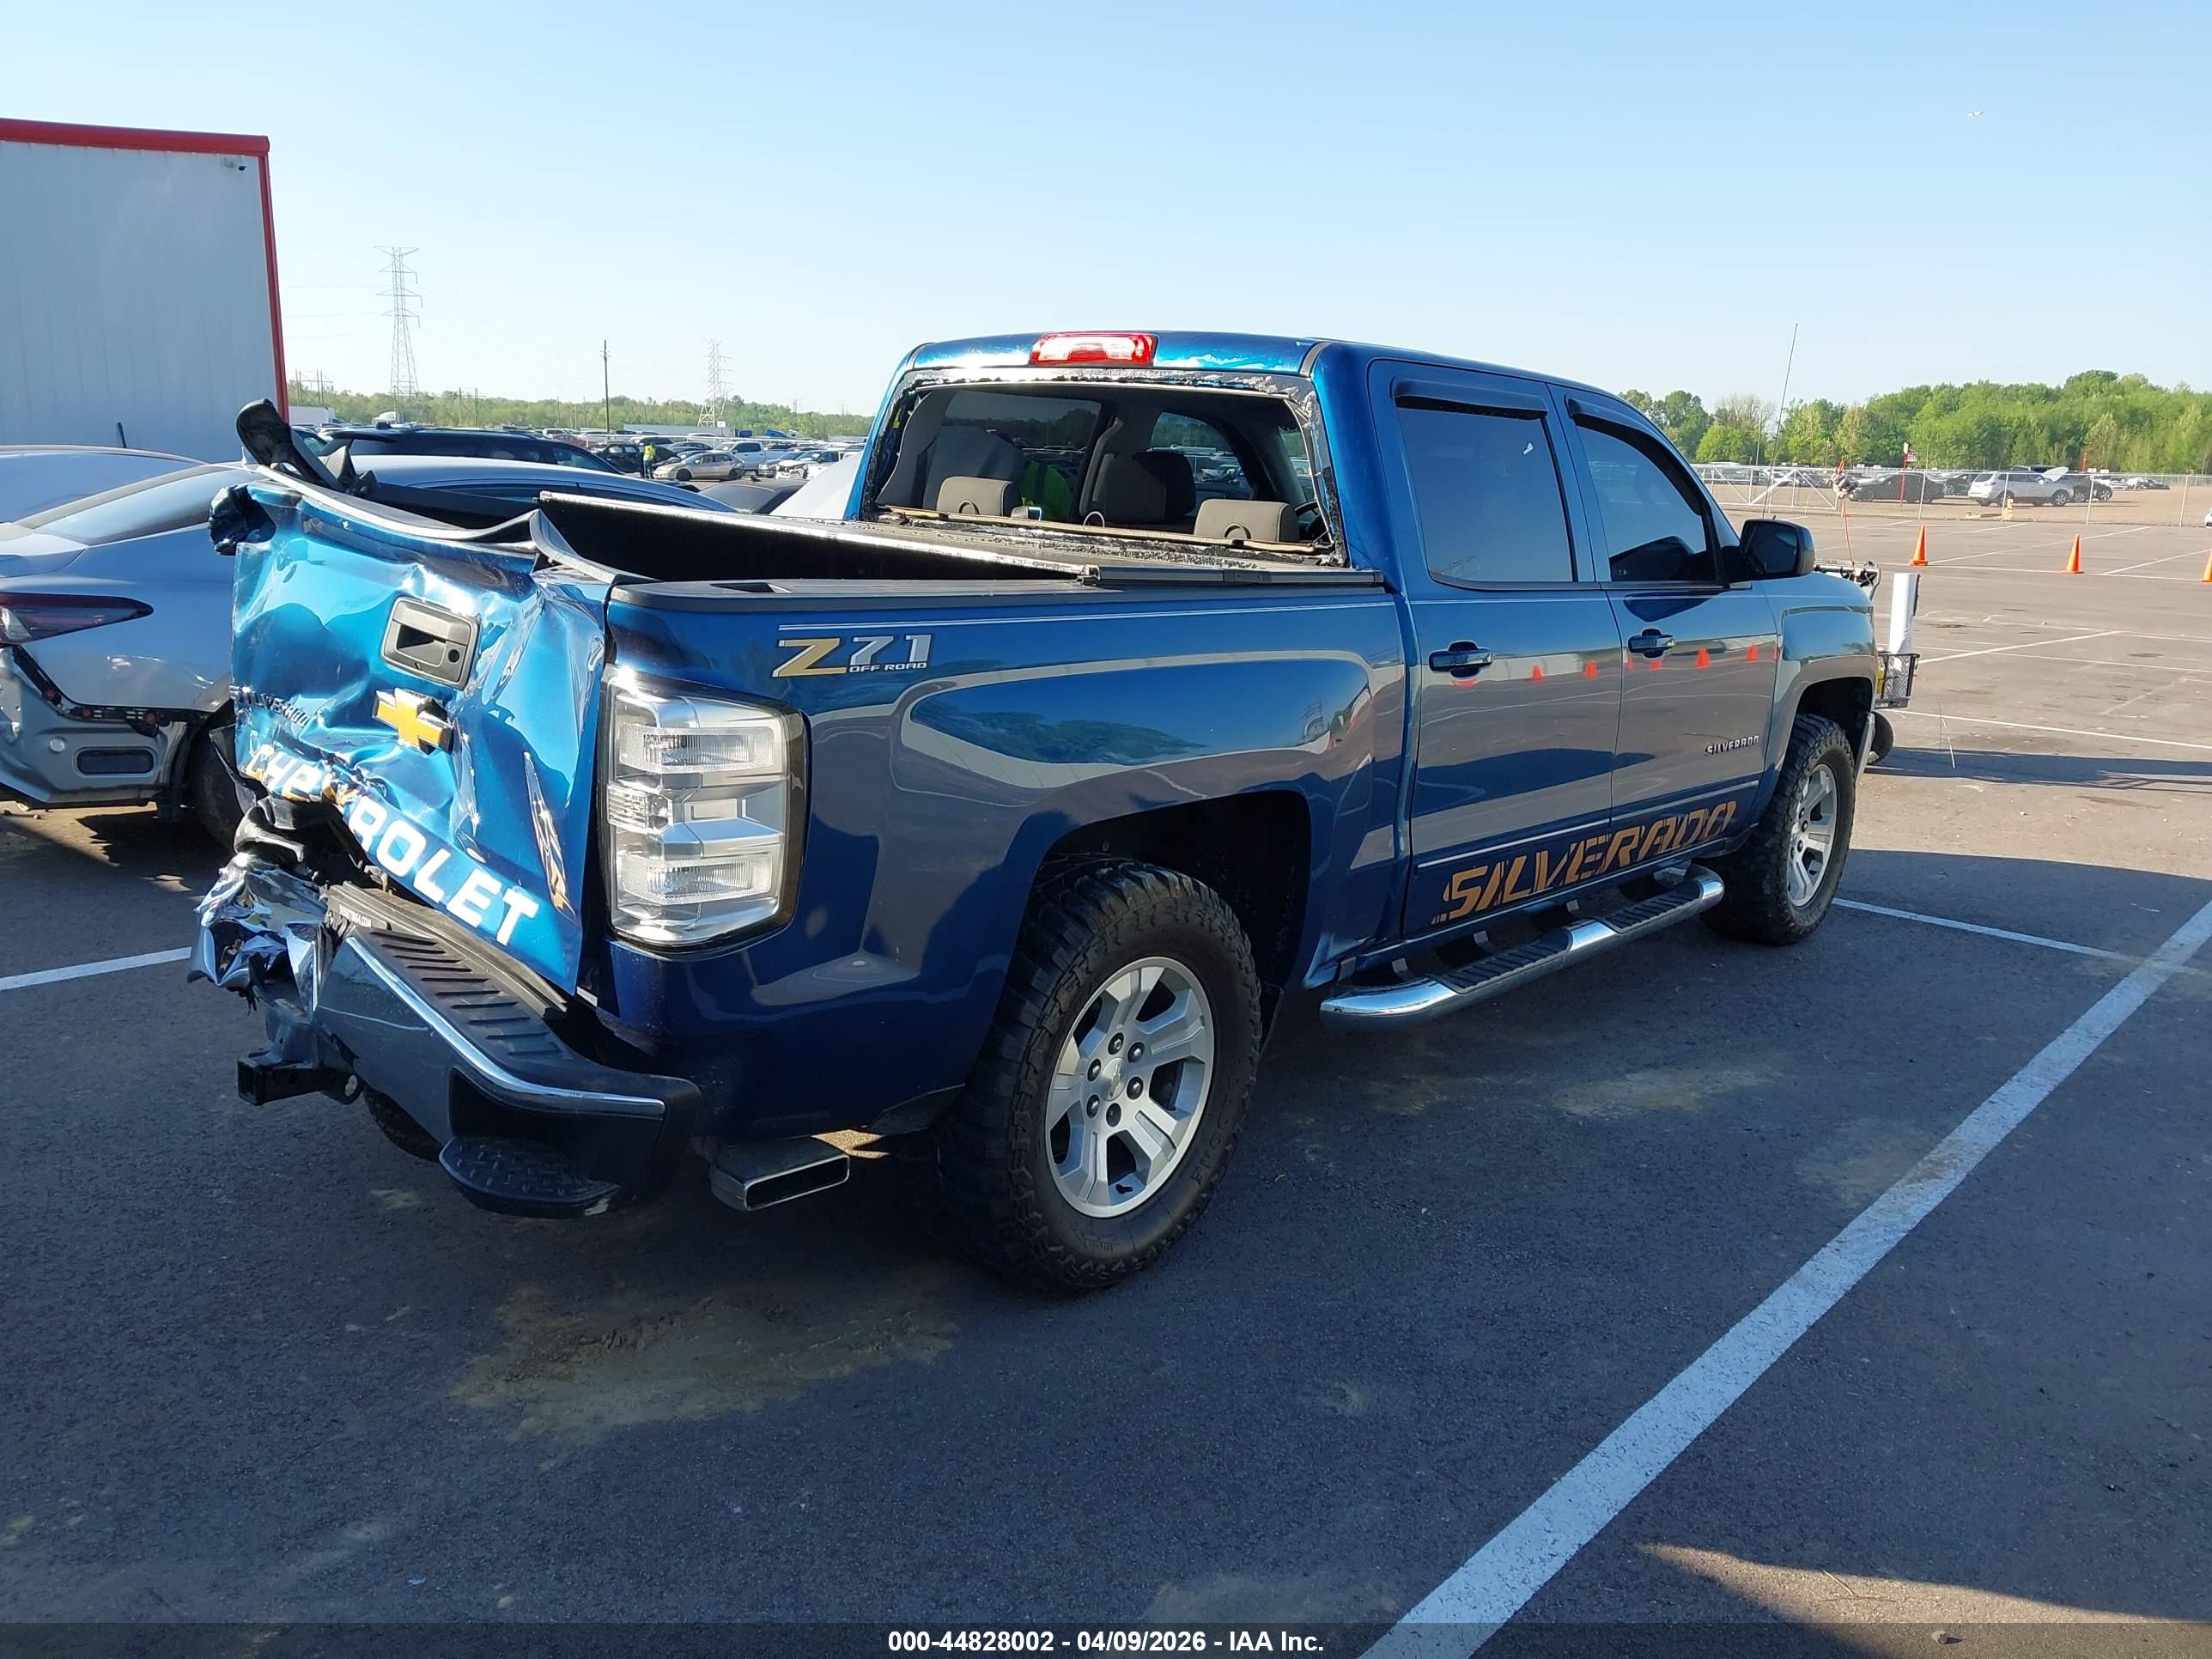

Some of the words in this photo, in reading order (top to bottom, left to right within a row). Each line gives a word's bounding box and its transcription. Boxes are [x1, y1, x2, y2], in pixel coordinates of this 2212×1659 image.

[772, 634, 933, 678] Z71
[848, 664, 880, 673] OFF
[884, 662, 927, 671] ROAD
[1705, 735, 1759, 754] SILVERADO
[1431, 800, 1736, 924] SILVERADO
